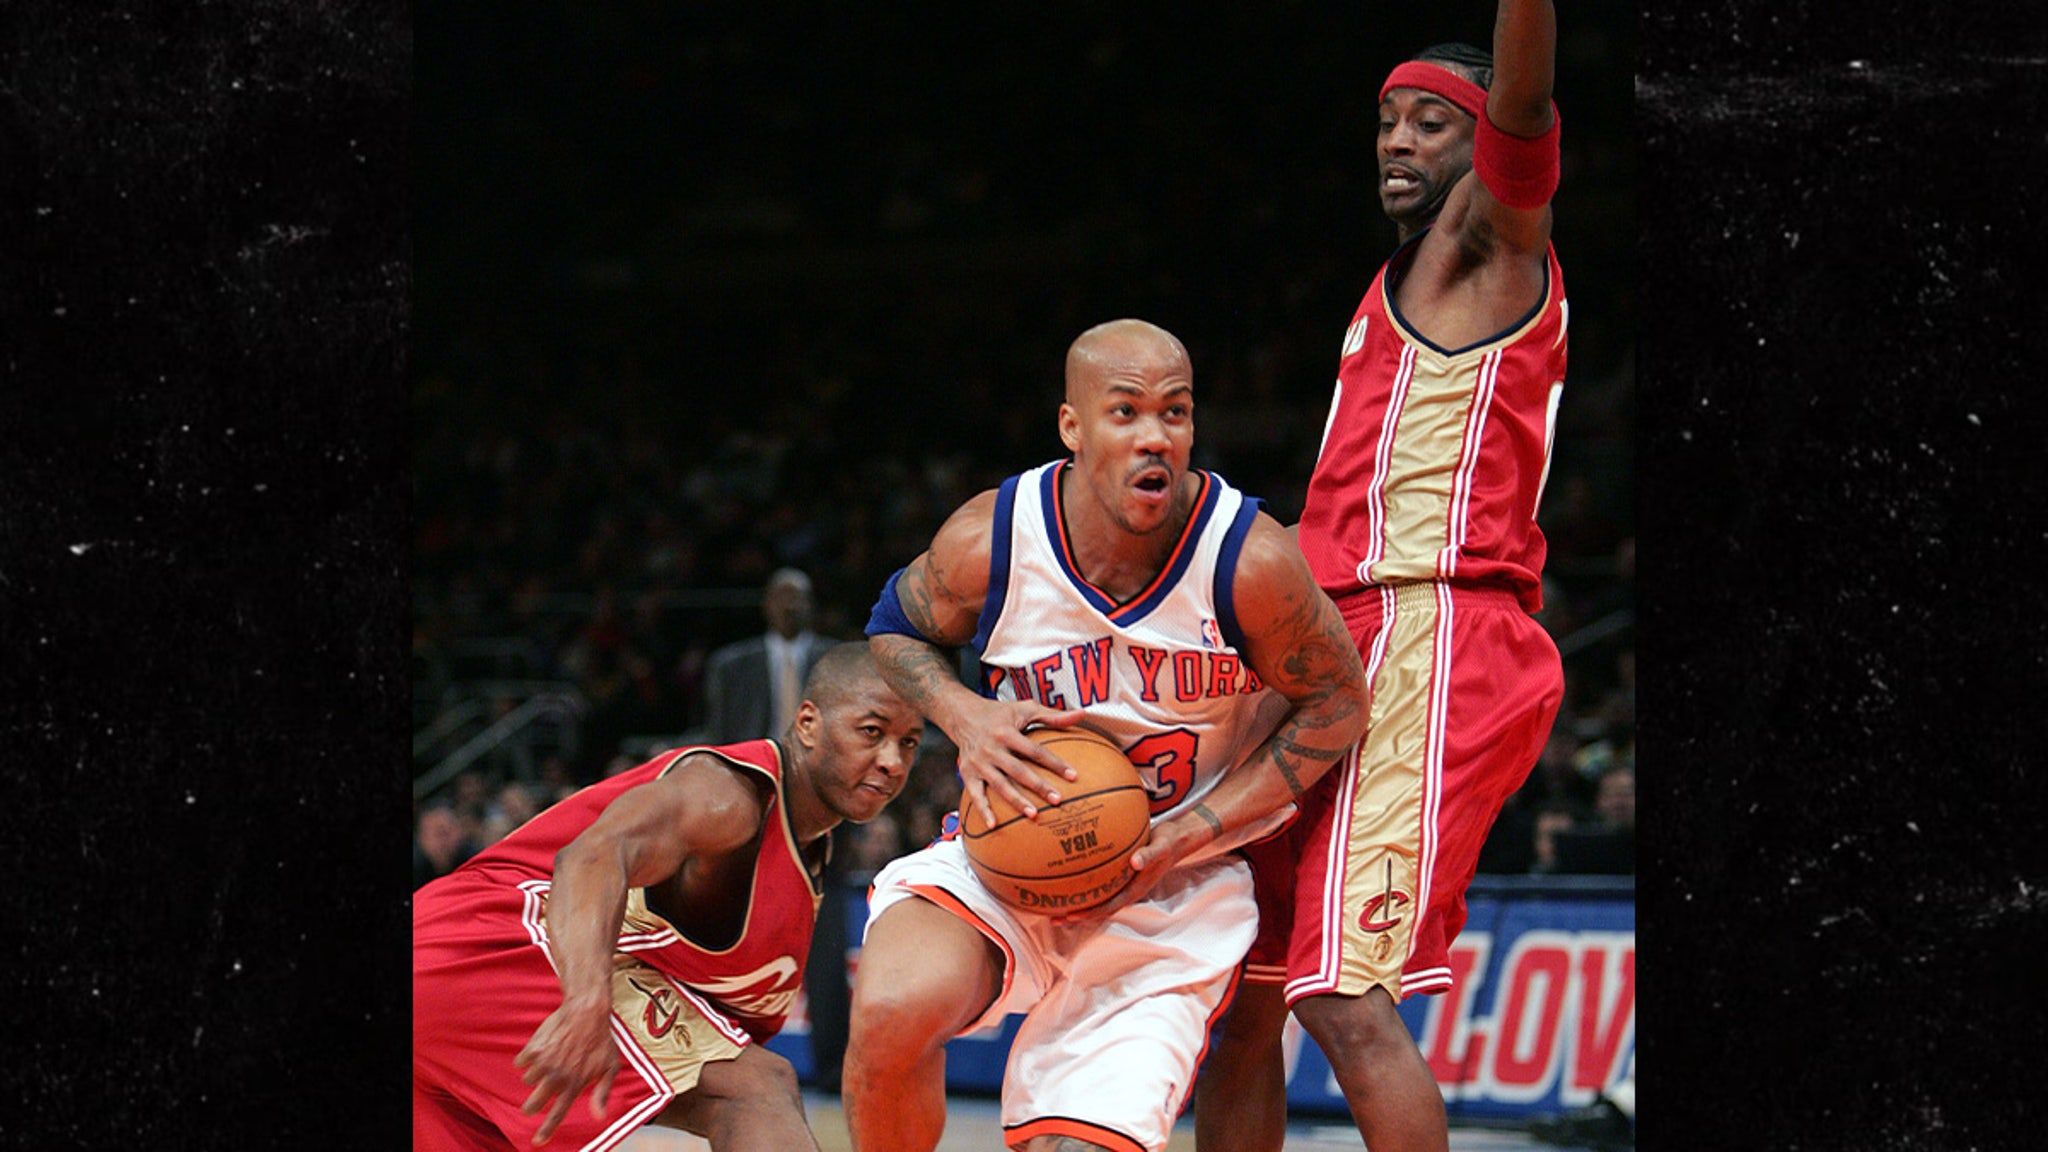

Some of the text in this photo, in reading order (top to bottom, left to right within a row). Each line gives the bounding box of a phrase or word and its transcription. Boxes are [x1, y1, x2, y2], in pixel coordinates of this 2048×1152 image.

[1009, 635, 1114, 711] NEW
[1123, 727, 1199, 818] 3
[1060, 830, 1098, 855] NBA
